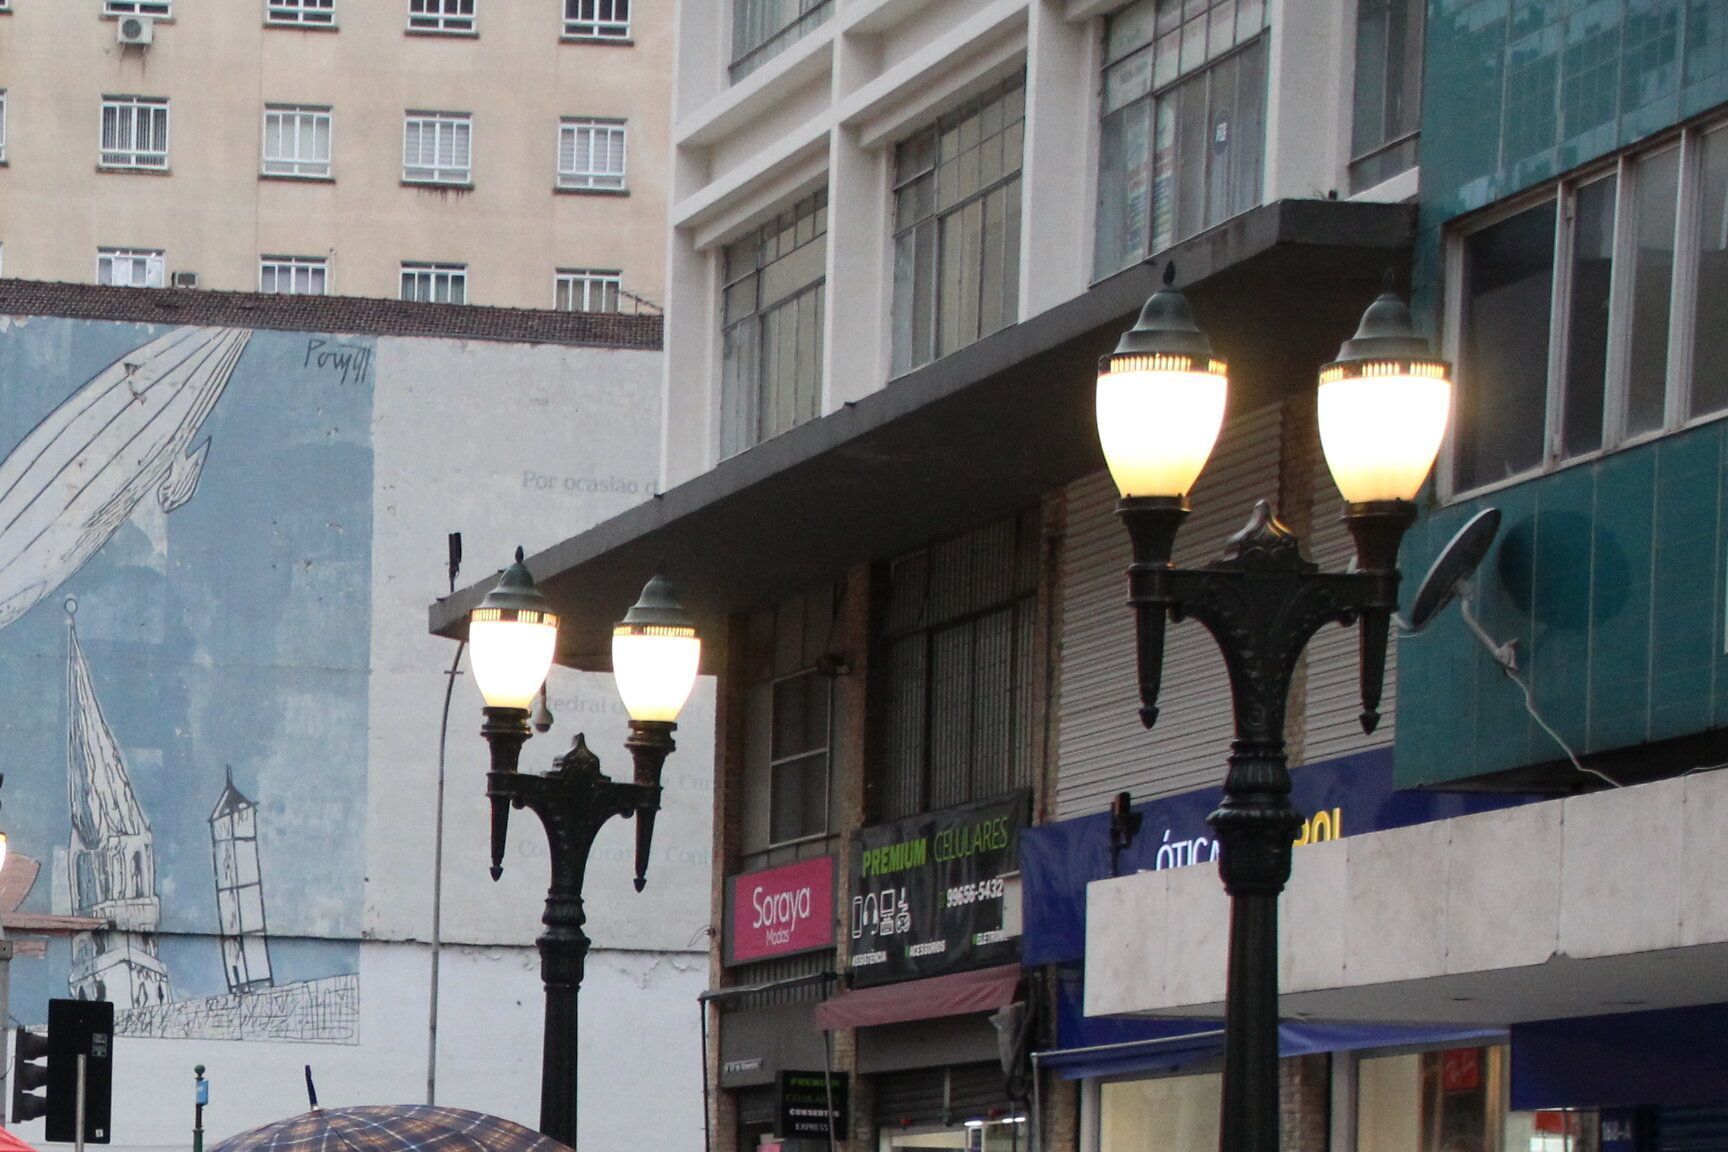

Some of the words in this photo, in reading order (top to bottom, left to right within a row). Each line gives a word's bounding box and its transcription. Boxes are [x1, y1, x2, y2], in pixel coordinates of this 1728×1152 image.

[523, 470, 557, 490] Por
[863, 838, 927, 878] PREMIUM
[933, 816, 1009, 863] CELULARES
[946, 878, 1005, 909] 99656-5432
[753, 886, 810, 932] Soraya
[766, 928, 790, 946] Modas
[909, 938, 946, 957] ACESSÓRIOS
[789, 1108, 840, 1117] CONSERTS
[795, 1122, 829, 1132] EXPRESS
